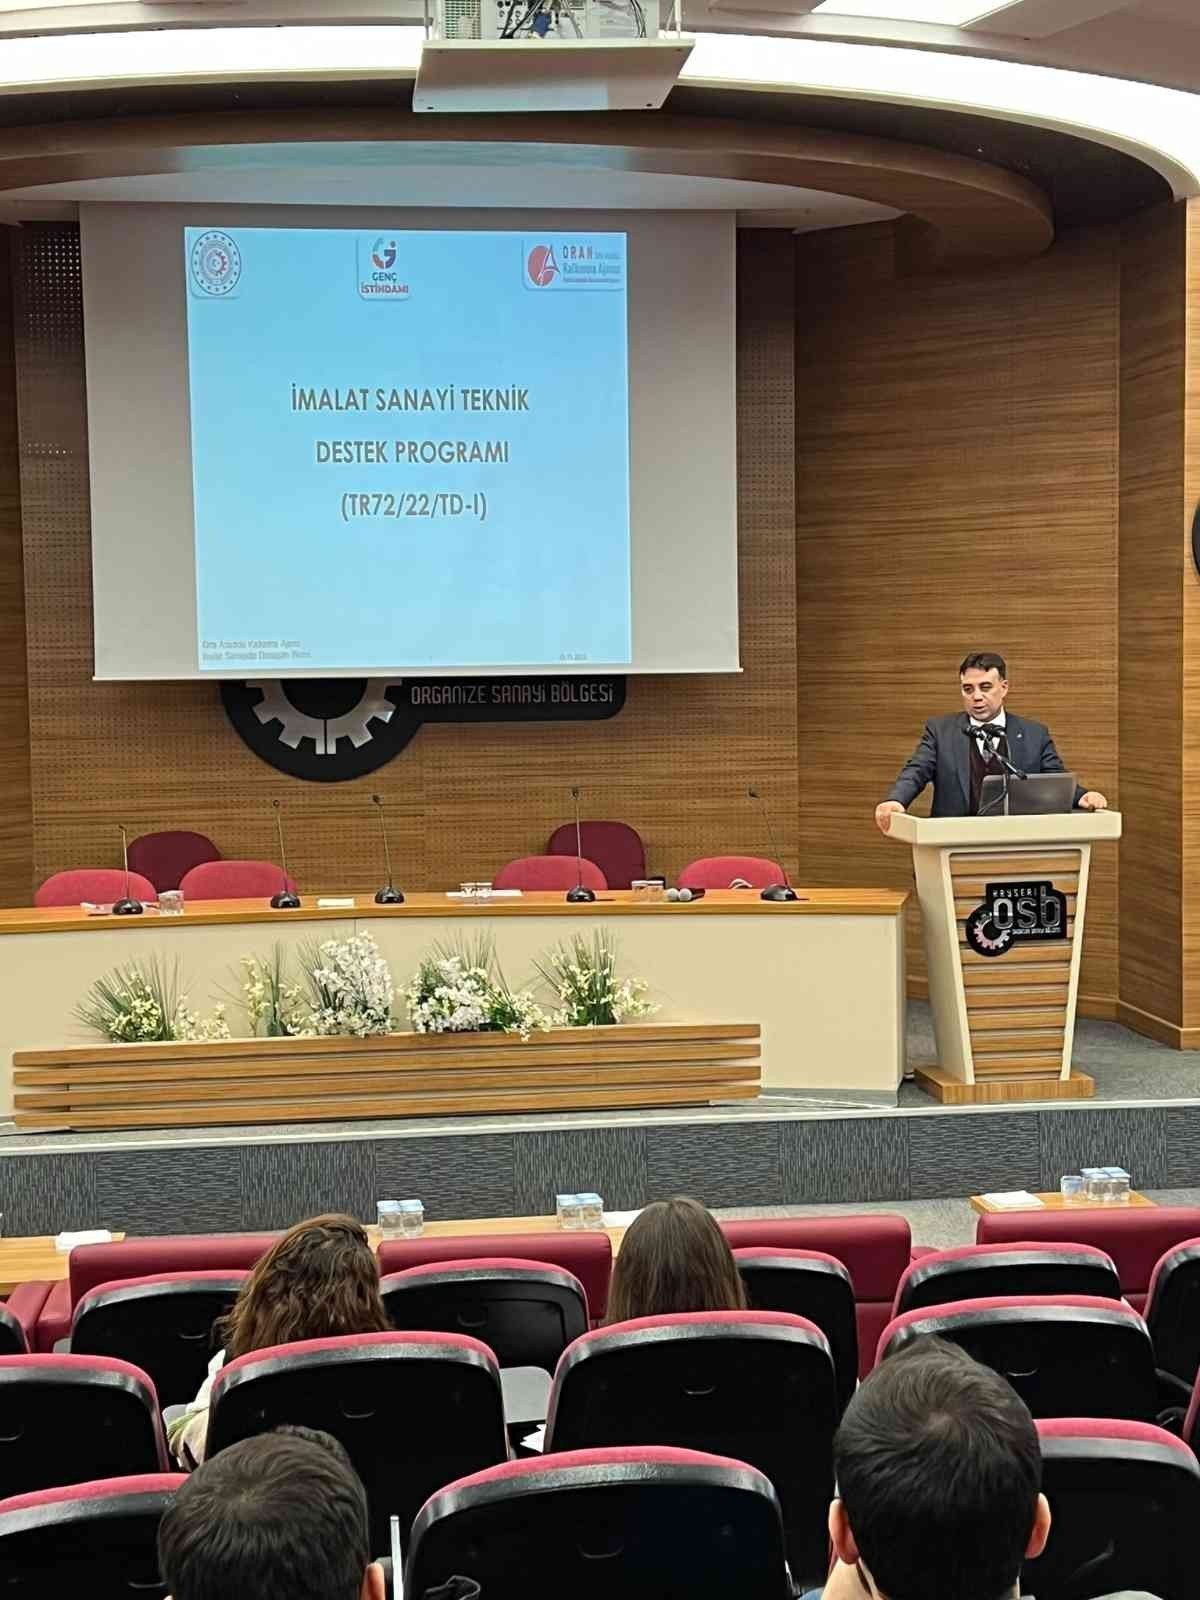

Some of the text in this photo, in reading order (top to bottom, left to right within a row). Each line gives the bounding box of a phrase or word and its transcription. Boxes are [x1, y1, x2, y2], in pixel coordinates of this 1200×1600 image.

[371, 271, 398, 284] GENÇ
[291, 383, 530, 411] İMALAT SANAYİ TEKNİK
[316, 440, 510, 463] DESTEK PROGRAMI
[341, 492, 488, 522] (TR72/22/TD-I)
